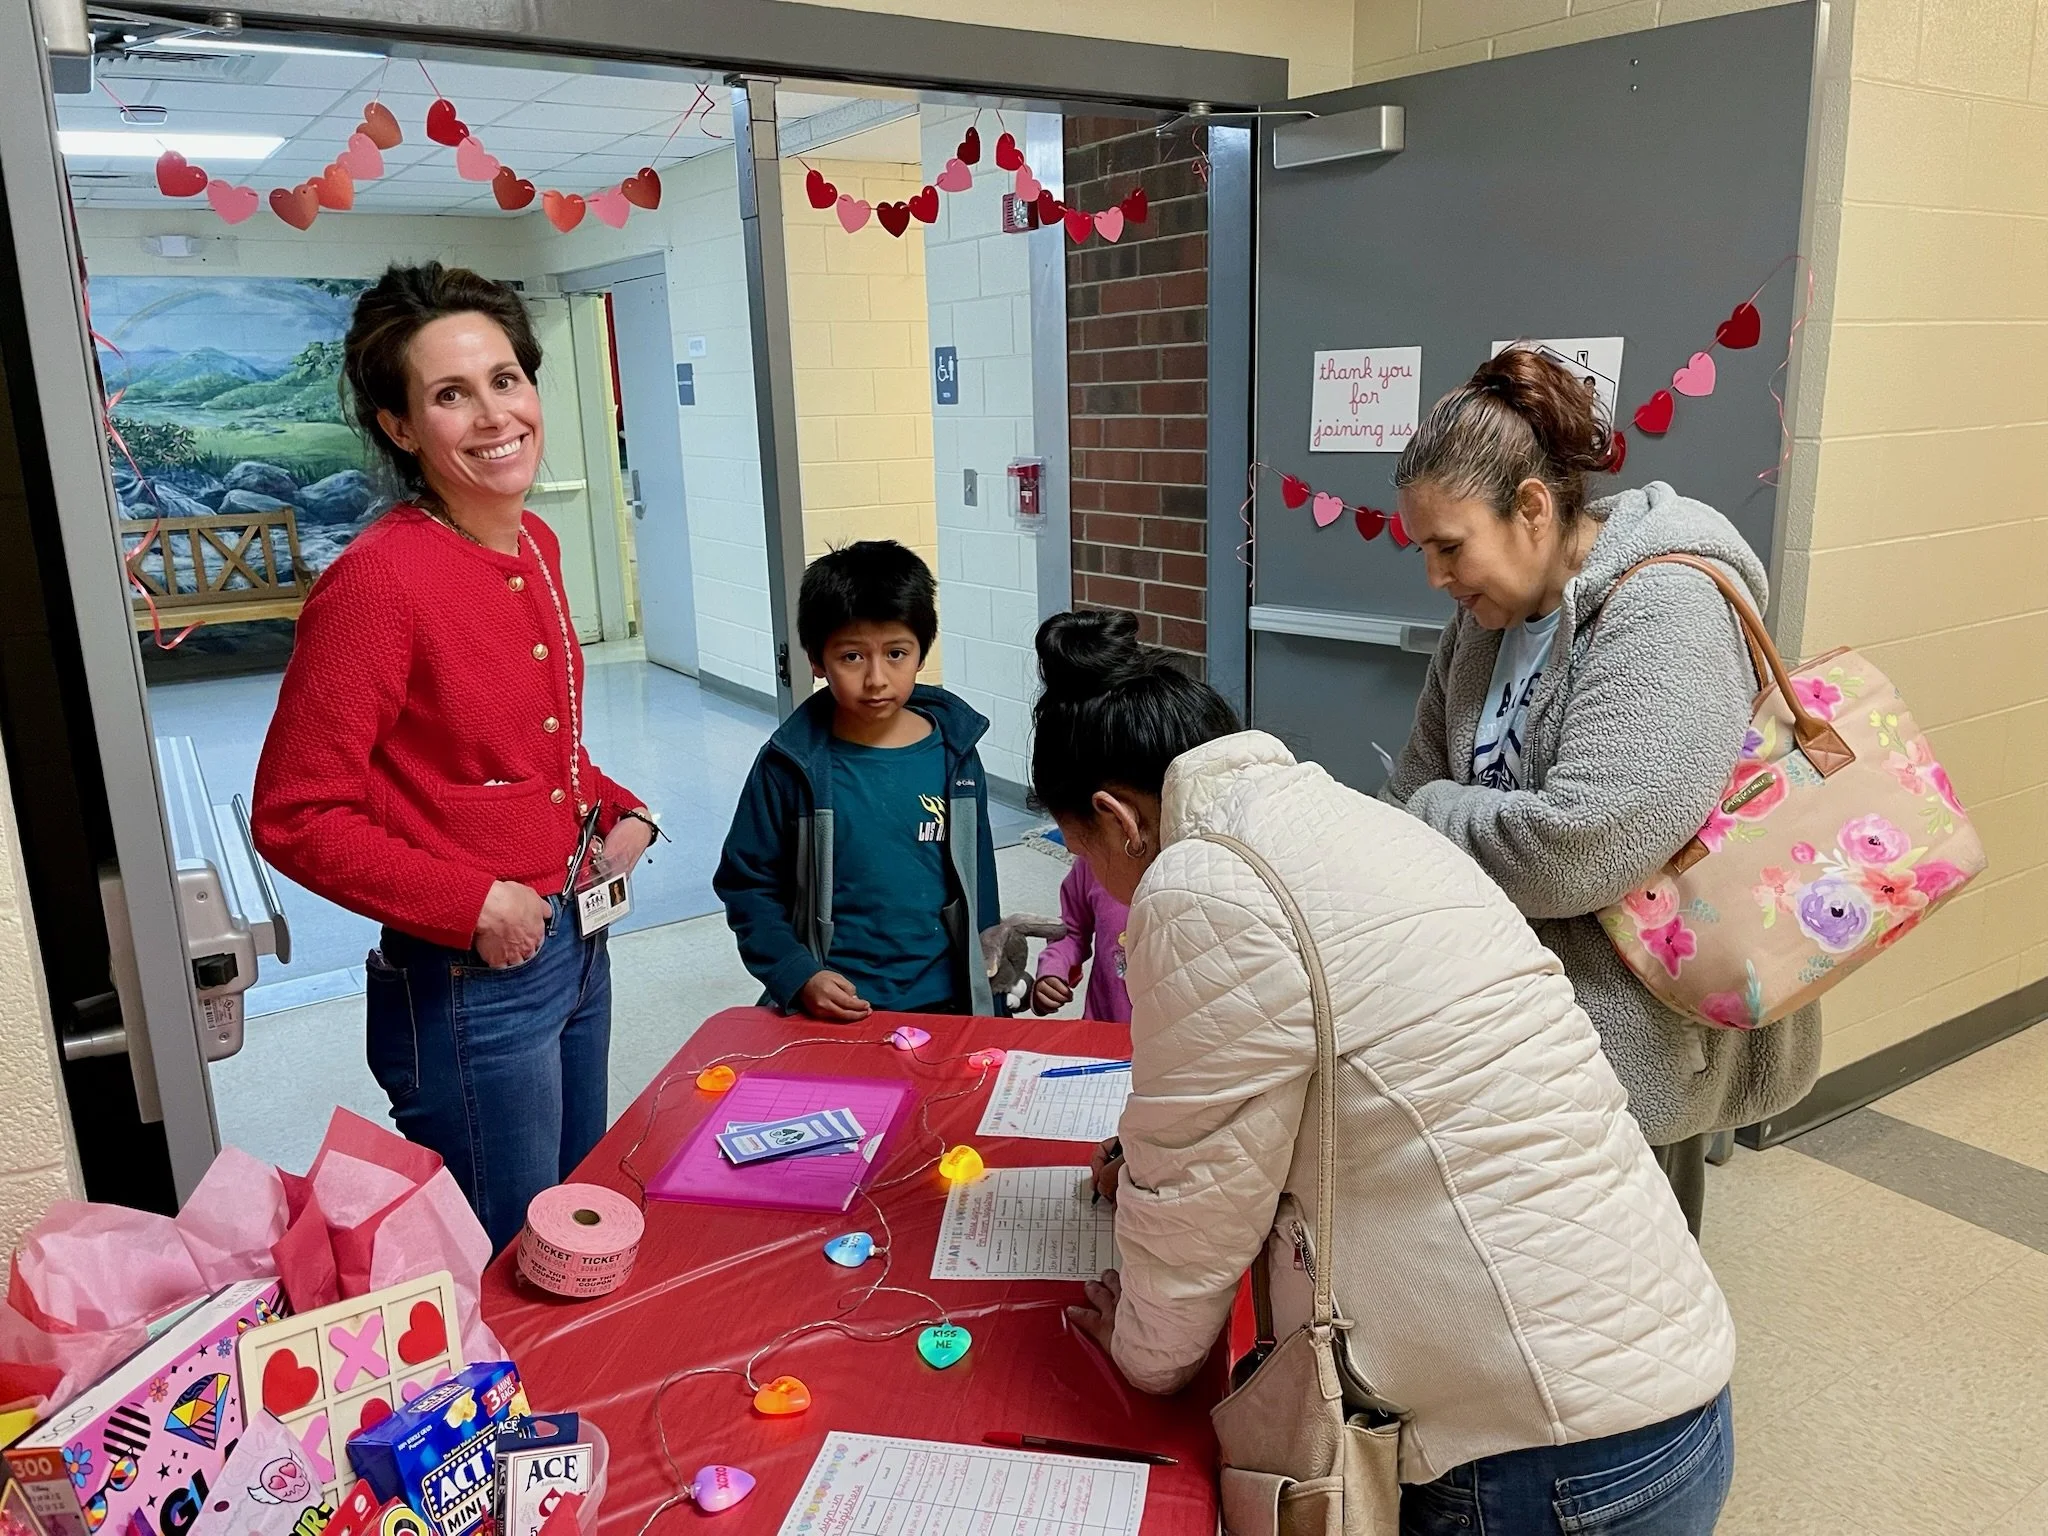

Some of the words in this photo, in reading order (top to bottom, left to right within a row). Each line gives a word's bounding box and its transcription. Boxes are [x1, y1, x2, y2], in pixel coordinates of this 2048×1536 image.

[1320, 356, 1373, 381] thank
[1378, 364, 1412, 390] you
[1349, 382, 1380, 415] for
[1313, 417, 1384, 447] joining
[1390, 422, 1414, 437] us
[918, 822, 935, 842] LOS
[536, 1238, 571, 1261] TICKET
[582, 1253, 622, 1265] TICKET
[532, 1267, 562, 1283] COUPON
[549, 1270, 566, 1280] THIS
[579, 1279, 612, 1287] COUPON
[599, 1273, 616, 1281] THIS
[933, 1330, 957, 1338] KISS
[936, 1340, 952, 1349] ME
[487, 1389, 501, 1410] 3
[498, 1375, 511, 1393] MINI
[501, 1386, 515, 1402] BAGS
[497, 1421, 519, 1433] ACE
[13, 1457, 53, 1479] 300
[441, 1451, 486, 1507] ACT
[525, 1455, 579, 1492] ACE
[714, 1466, 730, 1490] XOXO
[447, 1497, 483, 1533] MINI
[819, 1493, 844, 1533] sign-in
